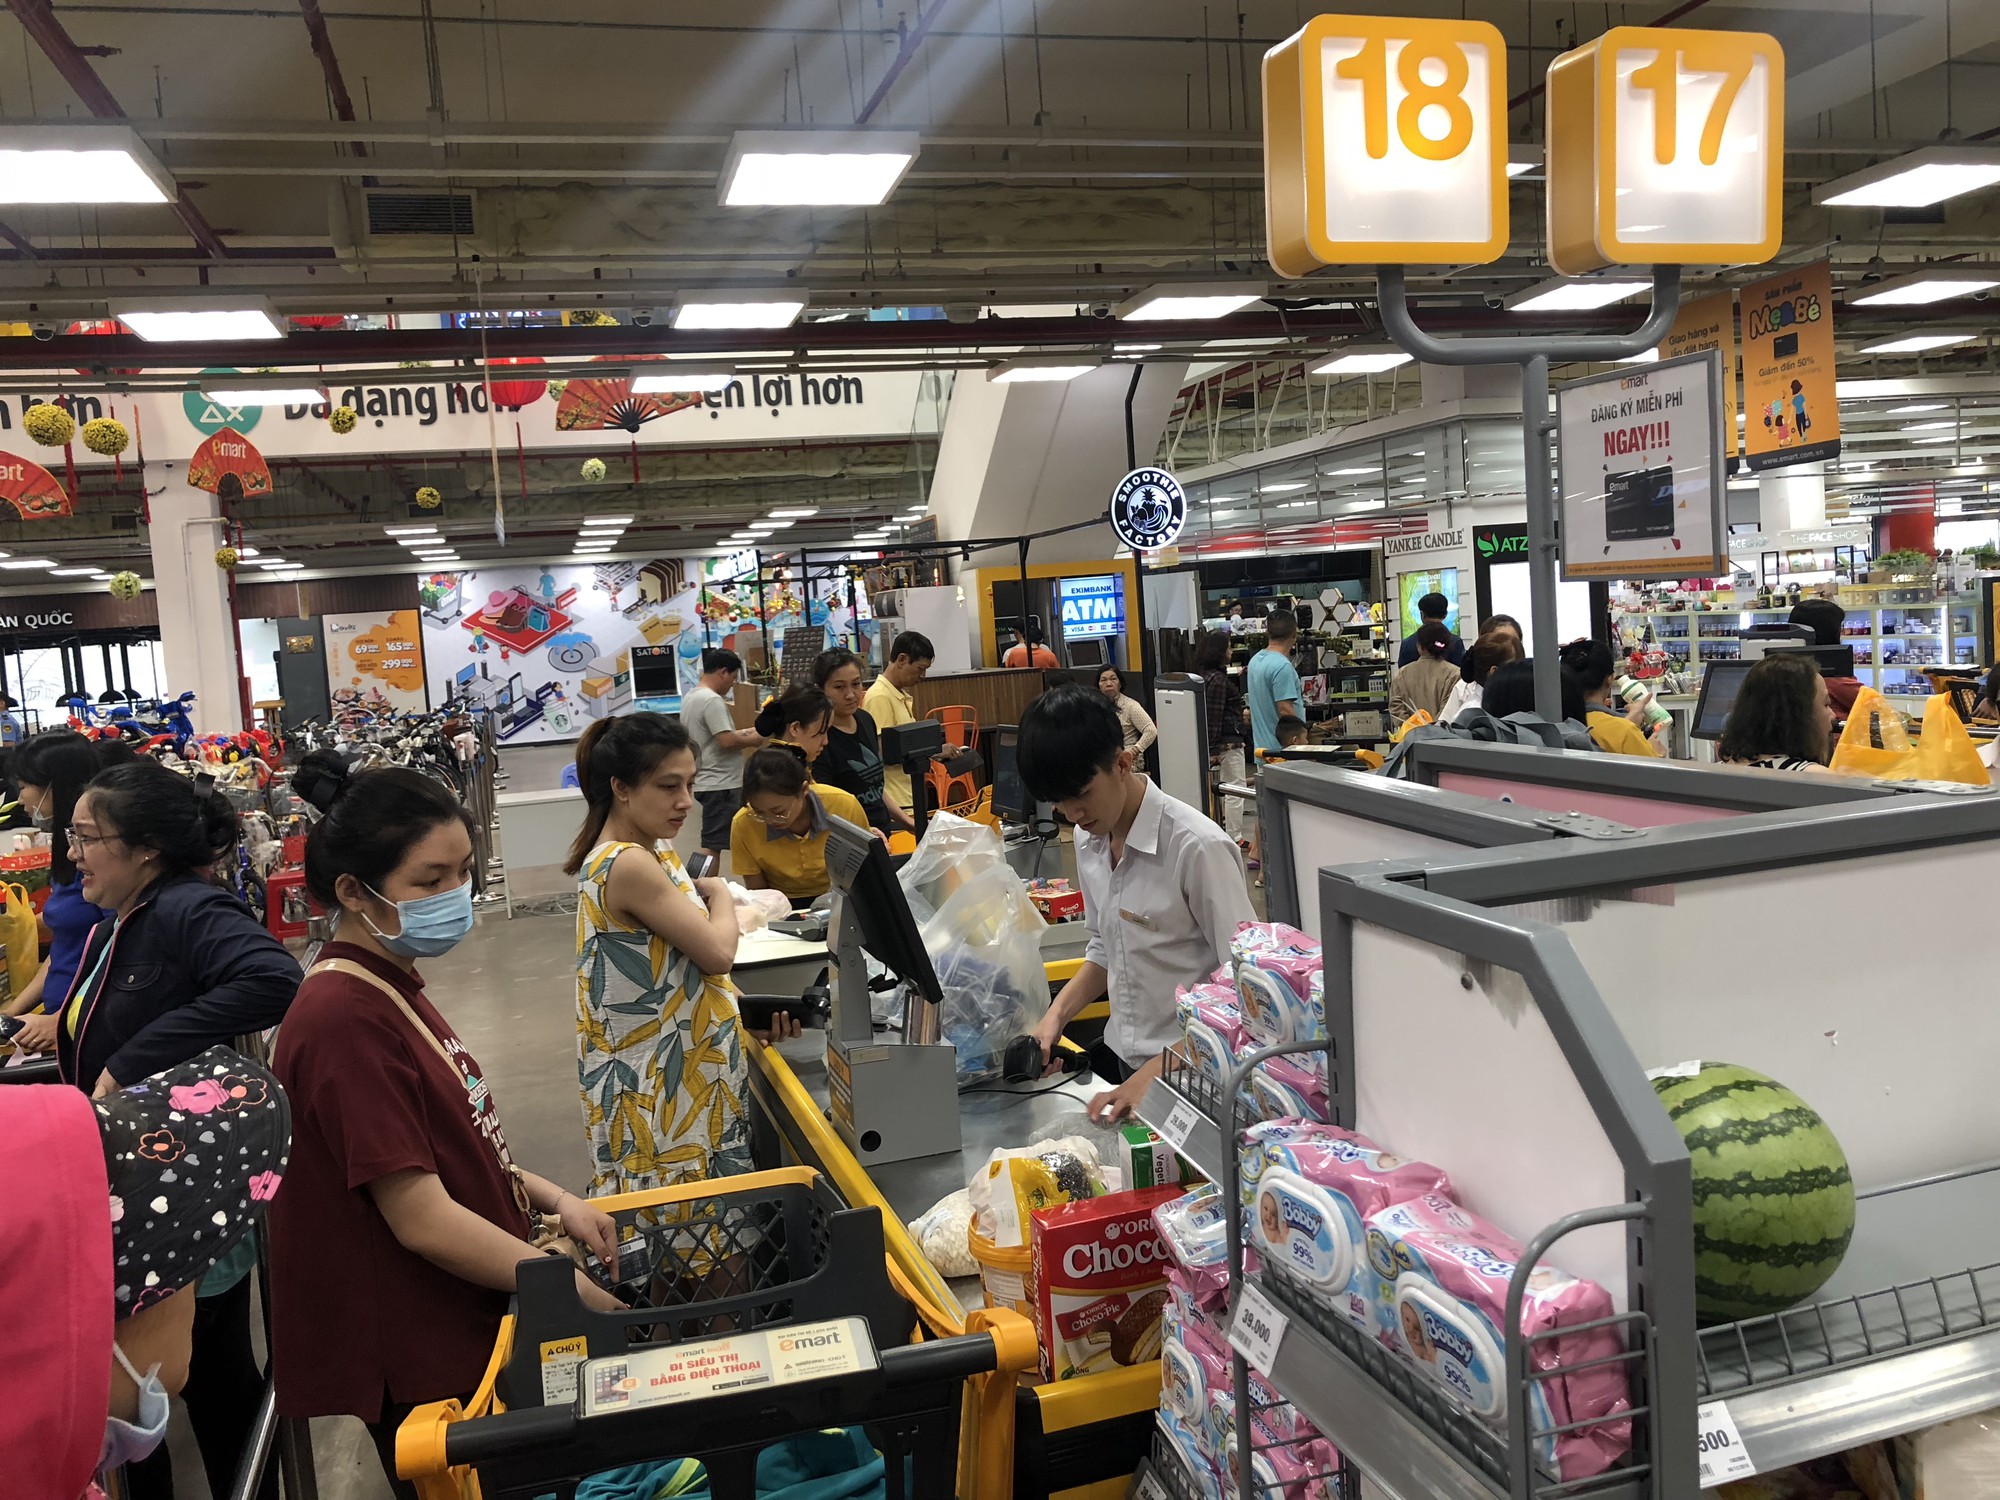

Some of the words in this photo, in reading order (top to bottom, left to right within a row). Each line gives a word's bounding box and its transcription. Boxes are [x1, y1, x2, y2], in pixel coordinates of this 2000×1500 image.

[1336, 37, 1474, 161] 18
[1630, 49, 1754, 166] 17
[1669, 334, 1687, 346] Giao
[1688, 327, 1708, 340] hàng
[1758, 366, 1779, 377] Giảm
[1780, 361, 1796, 373] đến
[1797, 355, 1815, 368] 50%
[1621, 373, 1649, 390] emart
[341, 384, 439, 428] dạng
[752, 374, 793, 417] lợi
[800, 373, 864, 406] hơn
[1591, 404, 1618, 423] ĐĂNG
[1620, 398, 1634, 417] KÝ
[1636, 389, 1662, 413] MIỄN
[1665, 387, 1683, 407] PHÍ
[212, 438, 247, 459] emart
[1603, 420, 1671, 457] NGAY!!!
[1118, 473, 1180, 502] SMOOTHIE
[1609, 481, 1630, 492] emart
[1119, 515, 1181, 546] FACTORY
[1386, 535, 1422, 554] YANKEE
[1424, 530, 1463, 549] CANDLE
[1071, 585, 1113, 594] EXIMBANK
[24, 609, 73, 629] QUỐC
[1062, 597, 1117, 621] ATM
[355, 644, 368, 654] 69
[386, 642, 402, 652] 165
[636, 646, 670, 657] SATORI
[381, 658, 401, 670] 299
[1282, 1196, 1323, 1236] Bobby
[1062, 1238, 1170, 1279] Choco
[1293, 1243, 1315, 1264] 99%
[1071, 1304, 1121, 1332] Choco-Pie
[1085, 1302, 1108, 1315] ORION
[1242, 1308, 1270, 1343] 39.000
[555, 1342, 575, 1354] CHÚ
[575, 1341, 582, 1351] Ý
[675, 1347, 705, 1359] emart
[707, 1341, 731, 1354] mall
[779, 1331, 842, 1352] emart
[1424, 1311, 1475, 1366] Bobby
[650, 1372, 686, 1387] BẰNG
[689, 1366, 720, 1380] ĐIỆN
[723, 1360, 762, 1373] THOẠI
[669, 1362, 683, 1372] ĐI
[686, 1353, 715, 1370] SIÊU
[718, 1353, 739, 1364] THỊ
[1444, 1365, 1471, 1393] 99%
[1250, 1380, 1272, 1404] obby
